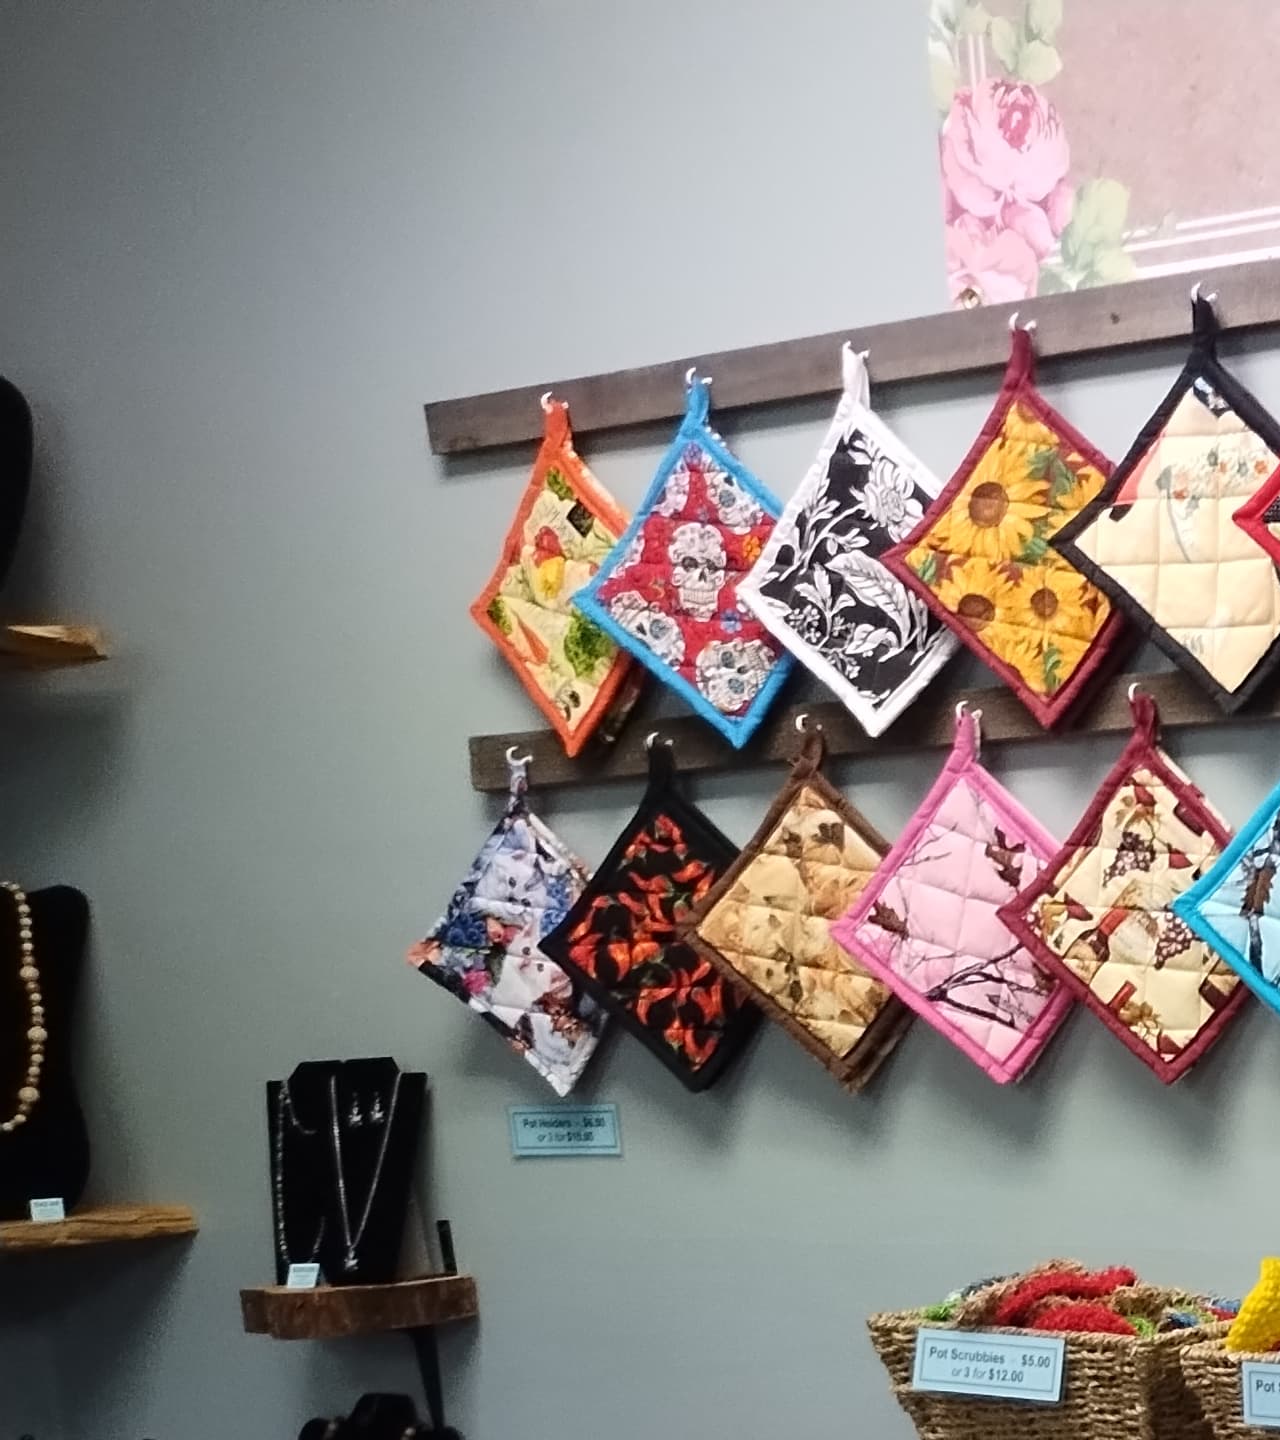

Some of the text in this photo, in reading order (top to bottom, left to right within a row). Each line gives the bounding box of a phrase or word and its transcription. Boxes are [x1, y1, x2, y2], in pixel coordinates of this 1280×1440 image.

[929, 1346, 1051, 1368] Pot Scrubbies $5.00
[951, 1366, 1024, 1382] or 3 for $12.00
[1255, 1380, 1275, 1392] Pot
